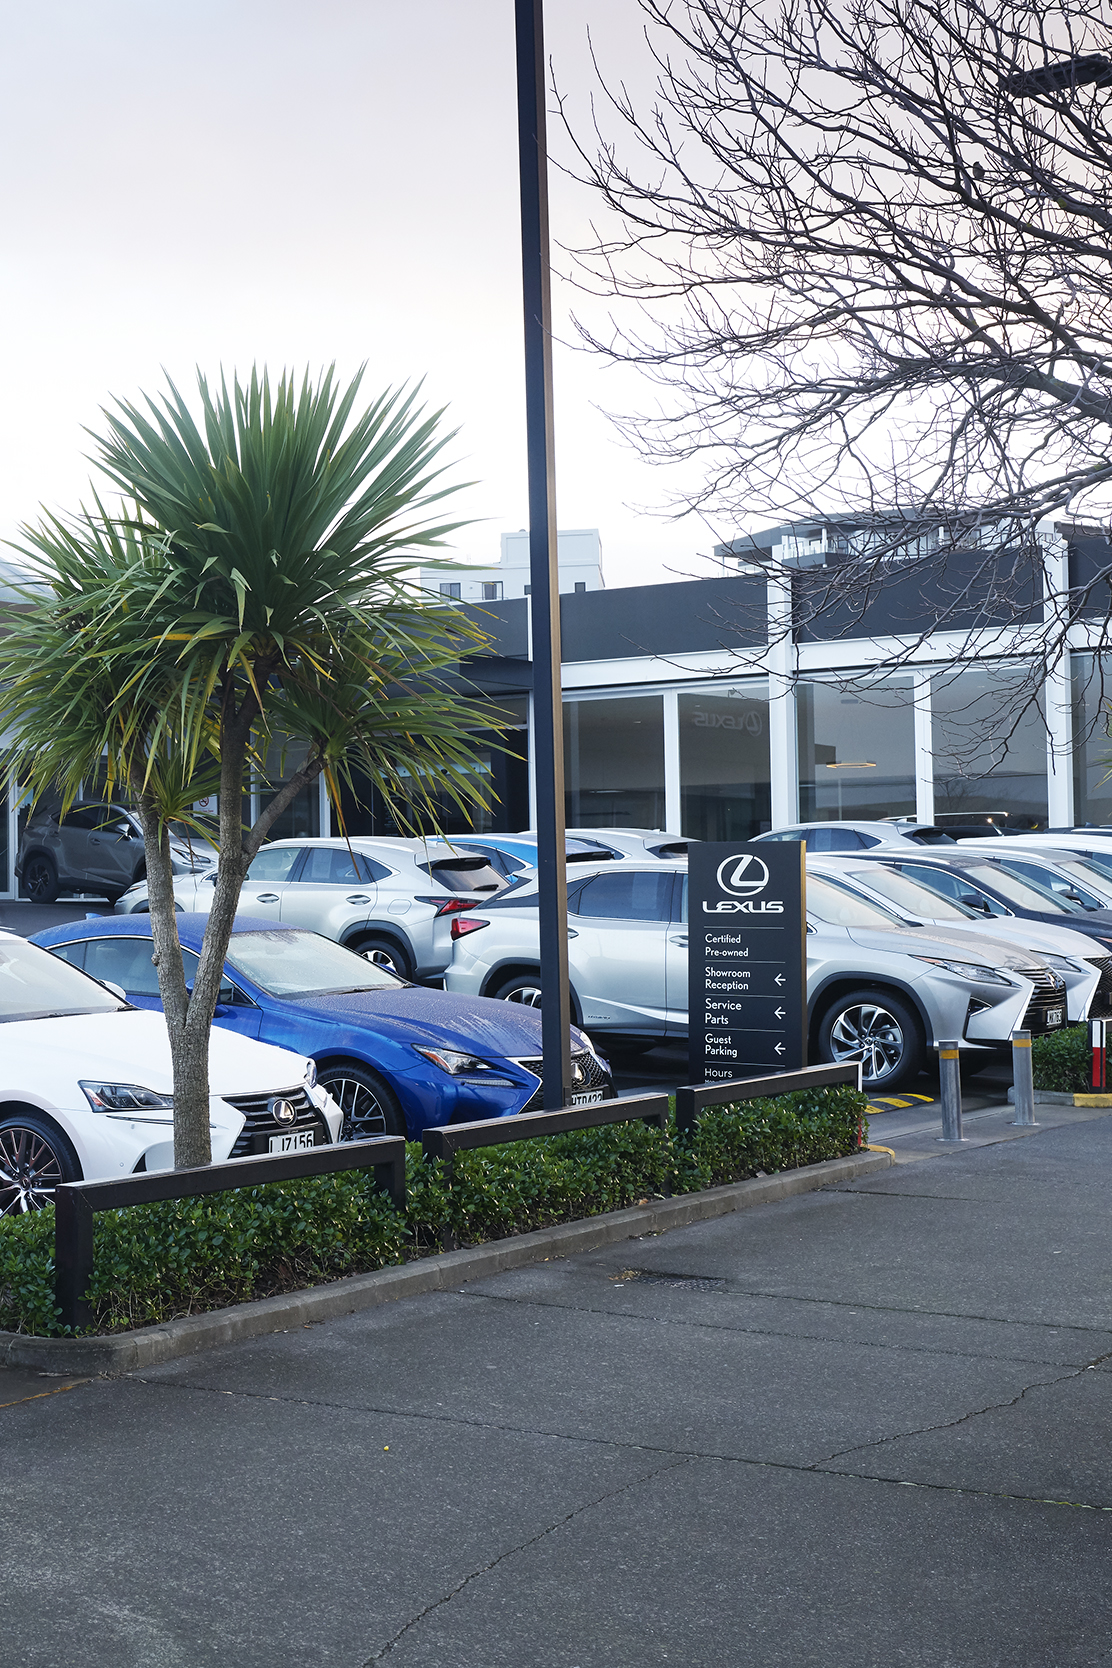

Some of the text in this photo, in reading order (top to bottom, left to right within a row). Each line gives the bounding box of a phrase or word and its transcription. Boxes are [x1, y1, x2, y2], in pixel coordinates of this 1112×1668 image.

[702, 900, 785, 913] LEXUS
[704, 933, 741, 944] Certified
[704, 946, 749, 957] Pre-owned
[704, 966, 751, 978] Showroom
[705, 979, 749, 991] Reception
[705, 998, 742, 1010] Service
[704, 1012, 729, 1025] Parts
[704, 1033, 732, 1044] Guest
[704, 1044, 738, 1058] Parking
[704, 1067, 733, 1078] Hours
